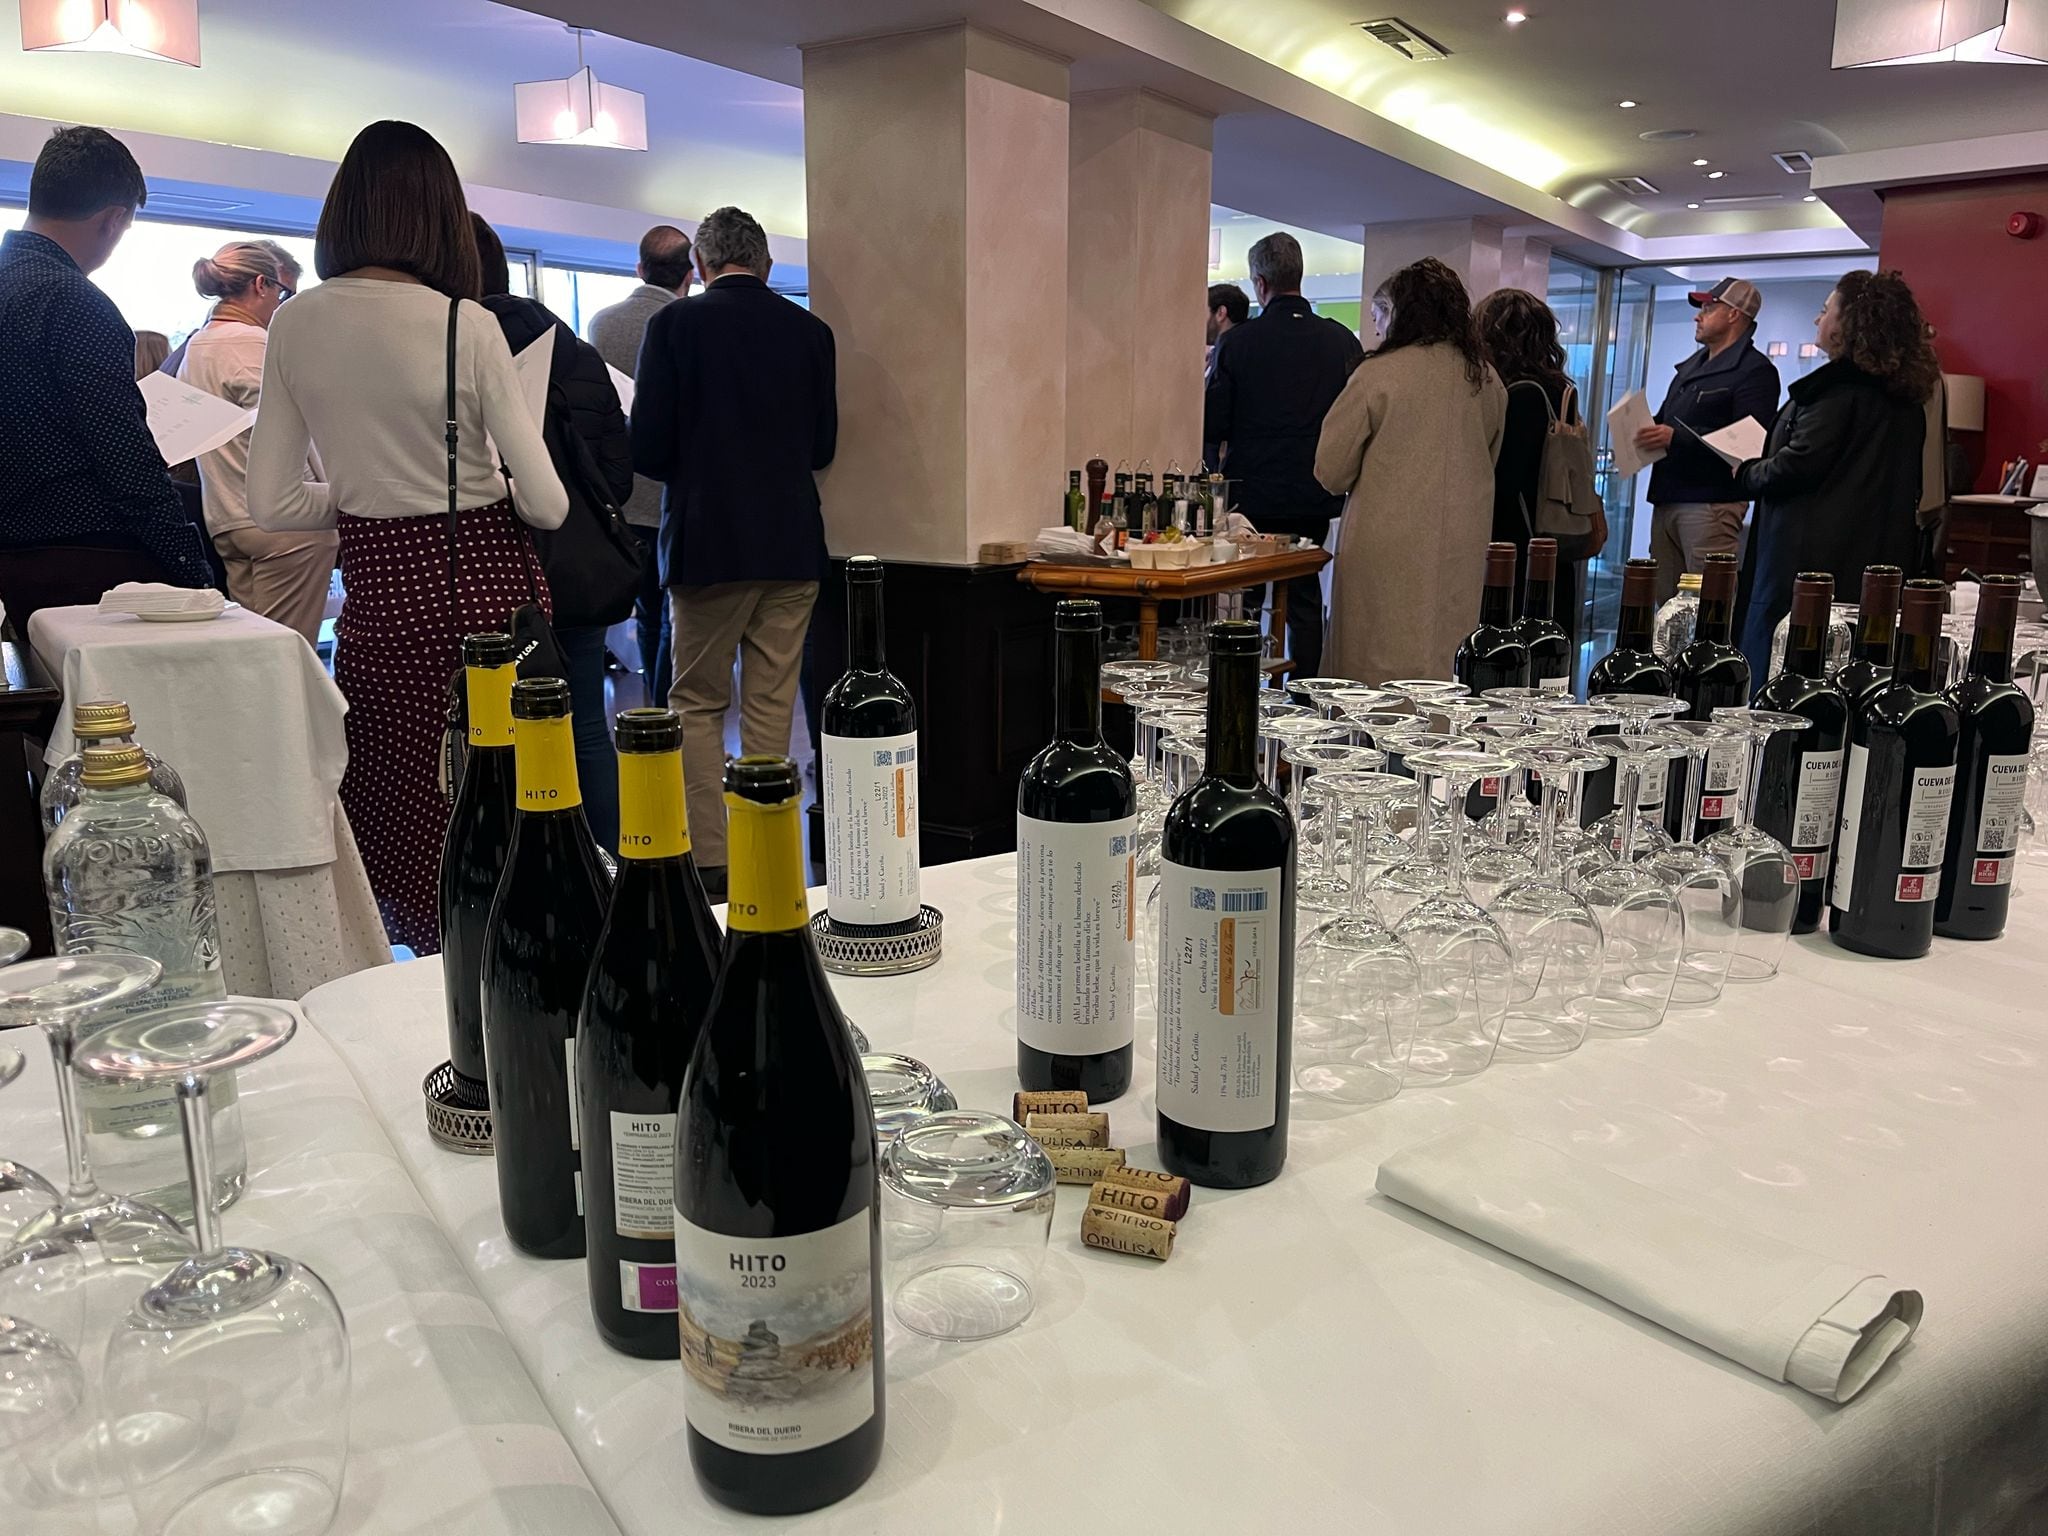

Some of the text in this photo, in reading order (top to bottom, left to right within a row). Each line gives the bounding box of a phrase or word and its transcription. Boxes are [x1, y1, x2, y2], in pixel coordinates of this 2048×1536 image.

[522, 640, 539, 656] LOLA
[1805, 760, 1839, 770] CUEVA DE
[1992, 765, 2017, 774] CUEVA
[1918, 777, 1951, 787] CUEVA DE
[525, 789, 558, 800] HITO
[874, 781, 882, 802] L22/1
[622, 834, 652, 846] HITO
[1047, 868, 1055, 878] ya
[1074, 861, 1082, 895] dedicado
[1073, 897, 1082, 920] hemos
[1094, 923, 1100, 931] es
[1075, 930, 1081, 938] te
[1092, 932, 1100, 948] vida
[1056, 944, 1064, 958] que
[1073, 939, 1081, 964] botella
[1083, 935, 1091, 961] famoso
[1184, 936, 1193, 965] L22/1
[1211, 948, 1218, 957] de
[1045, 951, 1053, 977] incluso
[1085, 963, 1091, 971] tu
[1198, 937, 1208, 994] Cosecha 2022
[1054, 974, 1062, 982] el
[1074, 965, 1083, 994] primera
[1176, 977, 1182, 986] es
[1073, 996, 1081, 1006] La
[1082, 987, 1091, 1025] brindando
[1045, 994, 1053, 1023] cosecha
[1174, 1007, 1181, 1015] la
[1189, 1070, 1199, 1094] Salud
[1026, 1103, 1078, 1114] HITO
[632, 1122, 661, 1132] HITO
[1116, 1165, 1174, 1182] HITO
[618, 1195, 642, 1205] RIBERA
[643, 1198, 657, 1206] DEL
[1100, 1187, 1159, 1210] HITO
[729, 1253, 786, 1272] HITO
[655, 1279, 677, 1287] COS
[740, 1275, 776, 1289] 2023
[728, 1422, 802, 1435] RIBERA DEL DUERO
